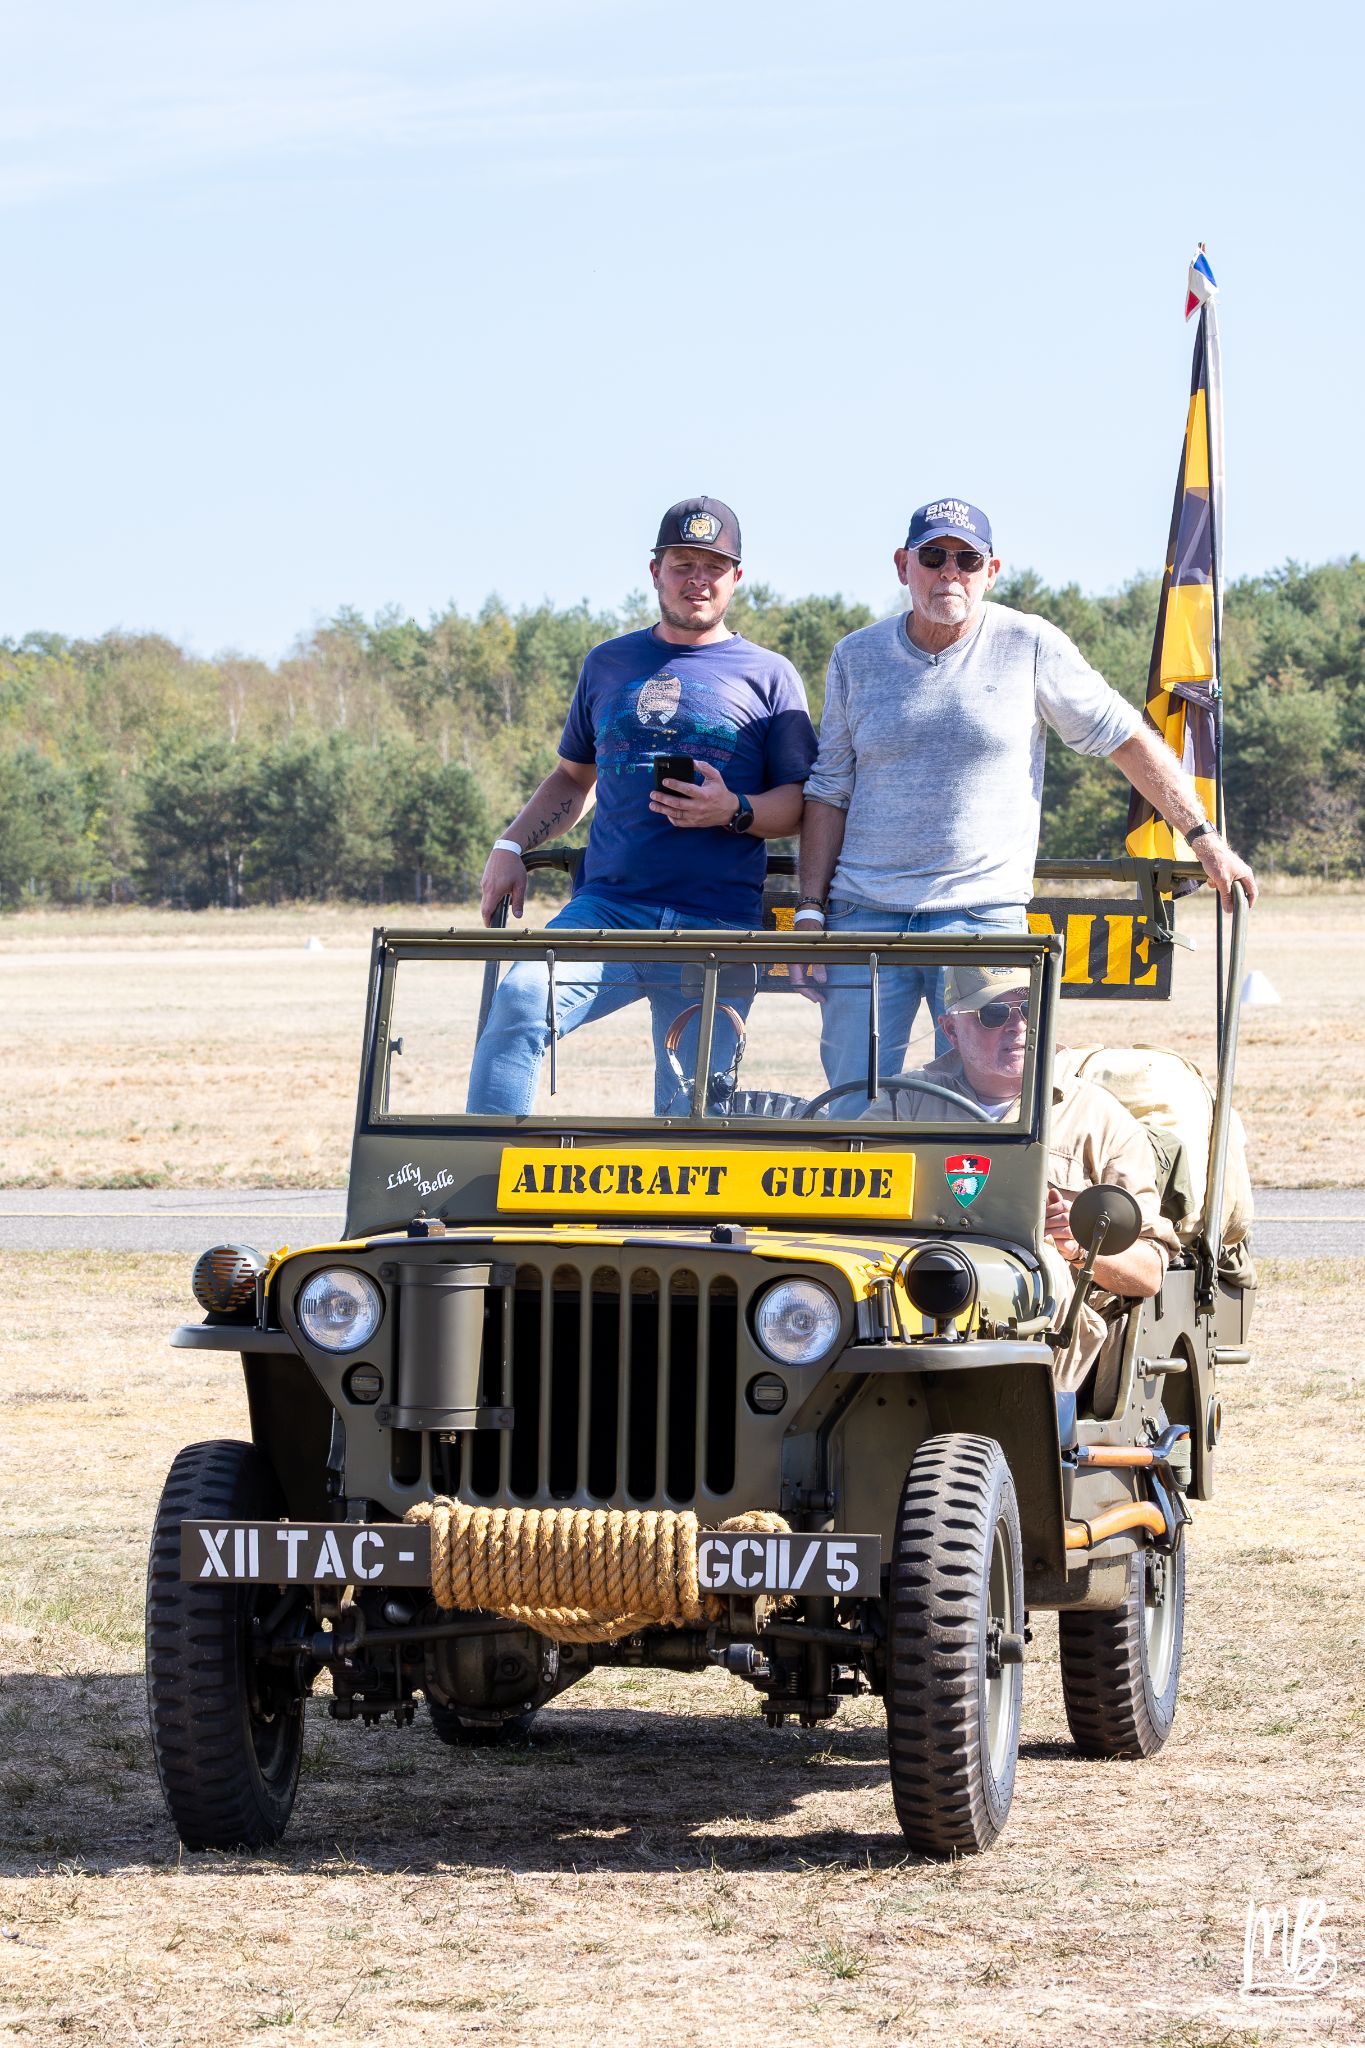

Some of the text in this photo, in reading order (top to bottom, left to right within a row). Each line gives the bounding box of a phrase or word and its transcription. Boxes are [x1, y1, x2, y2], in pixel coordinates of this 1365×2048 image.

[925, 511, 969, 522] PASSION
[926, 501, 969, 514] BMW
[948, 517, 977, 533] TOUR
[386, 1163, 455, 1196] Lilly Belle
[511, 1164, 893, 1199] AIRCRAFT GUIDE
[198, 1529, 260, 1578] XII
[276, 1530, 385, 1580] TAC
